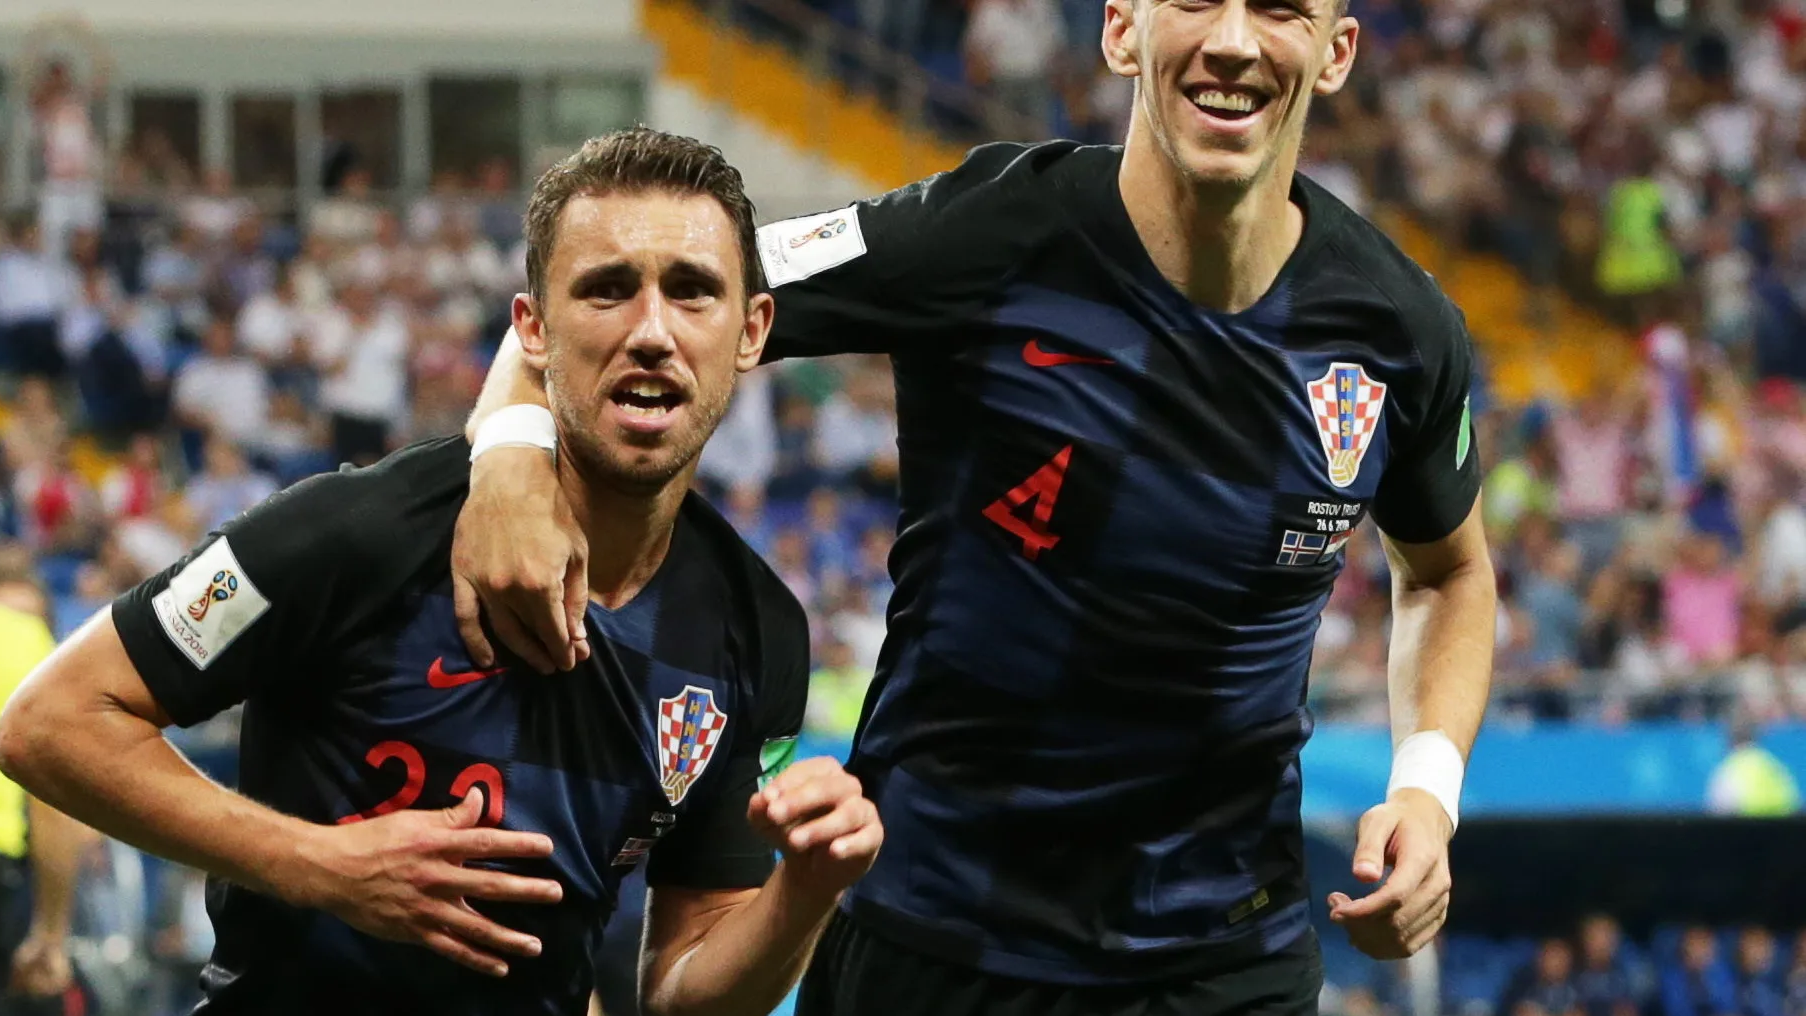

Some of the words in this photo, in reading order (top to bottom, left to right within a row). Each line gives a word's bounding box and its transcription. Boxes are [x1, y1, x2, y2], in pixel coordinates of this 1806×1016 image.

[1339, 376, 1353, 437] HNS
[982, 444, 1073, 561] 4
[1307, 501, 1342, 516] ROSTOV
[184, 634, 209, 659] 2018
[679, 700, 701, 759] HNS
